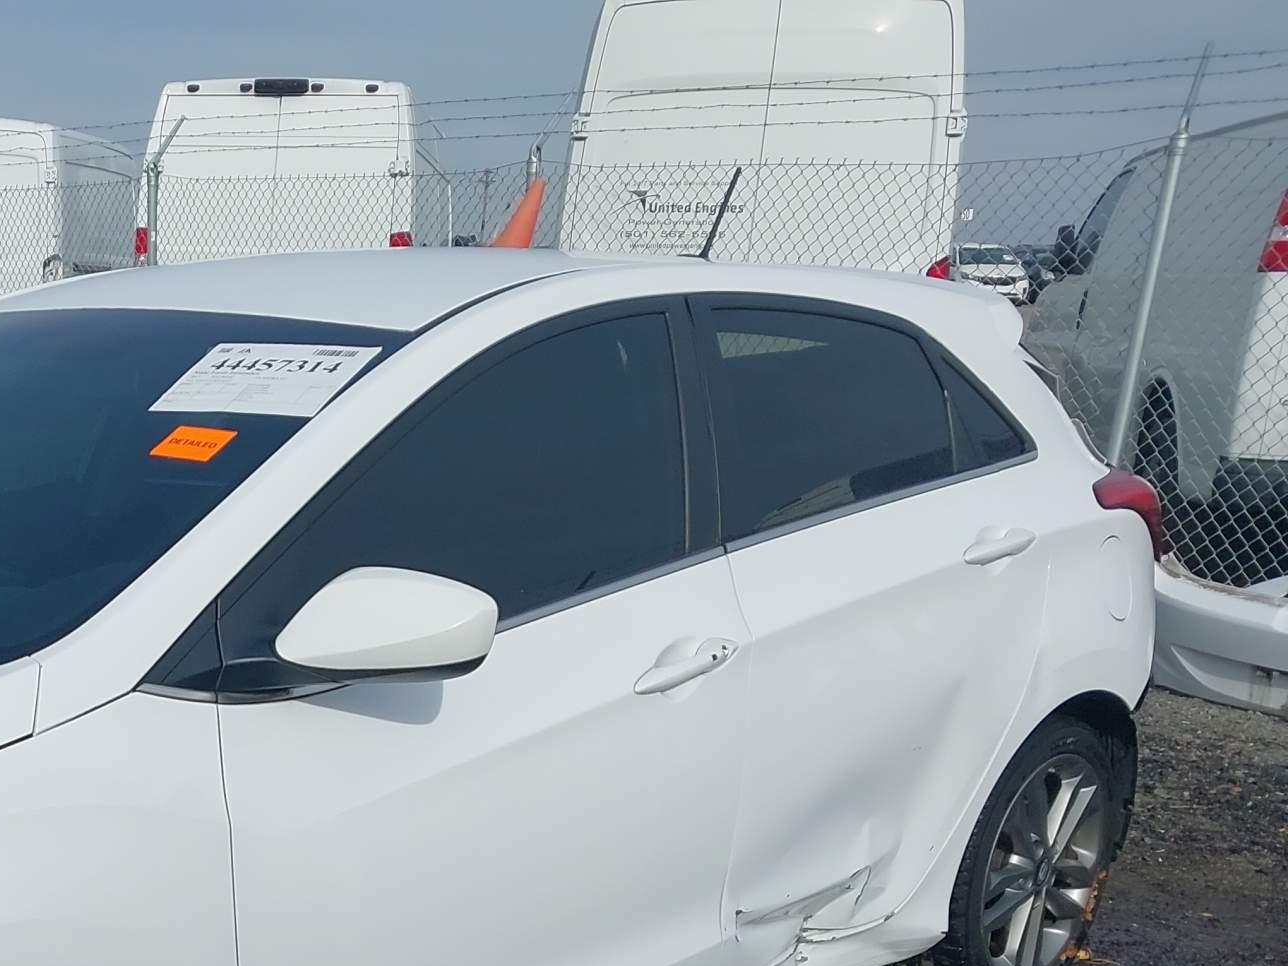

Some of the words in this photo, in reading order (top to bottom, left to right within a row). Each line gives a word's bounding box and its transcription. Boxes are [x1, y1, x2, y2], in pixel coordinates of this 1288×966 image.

[648, 201, 692, 214] United
[660, 230, 726, 239] 562-656
[211, 358, 344, 374] 44457314
[167, 437, 218, 450] DETAILED
